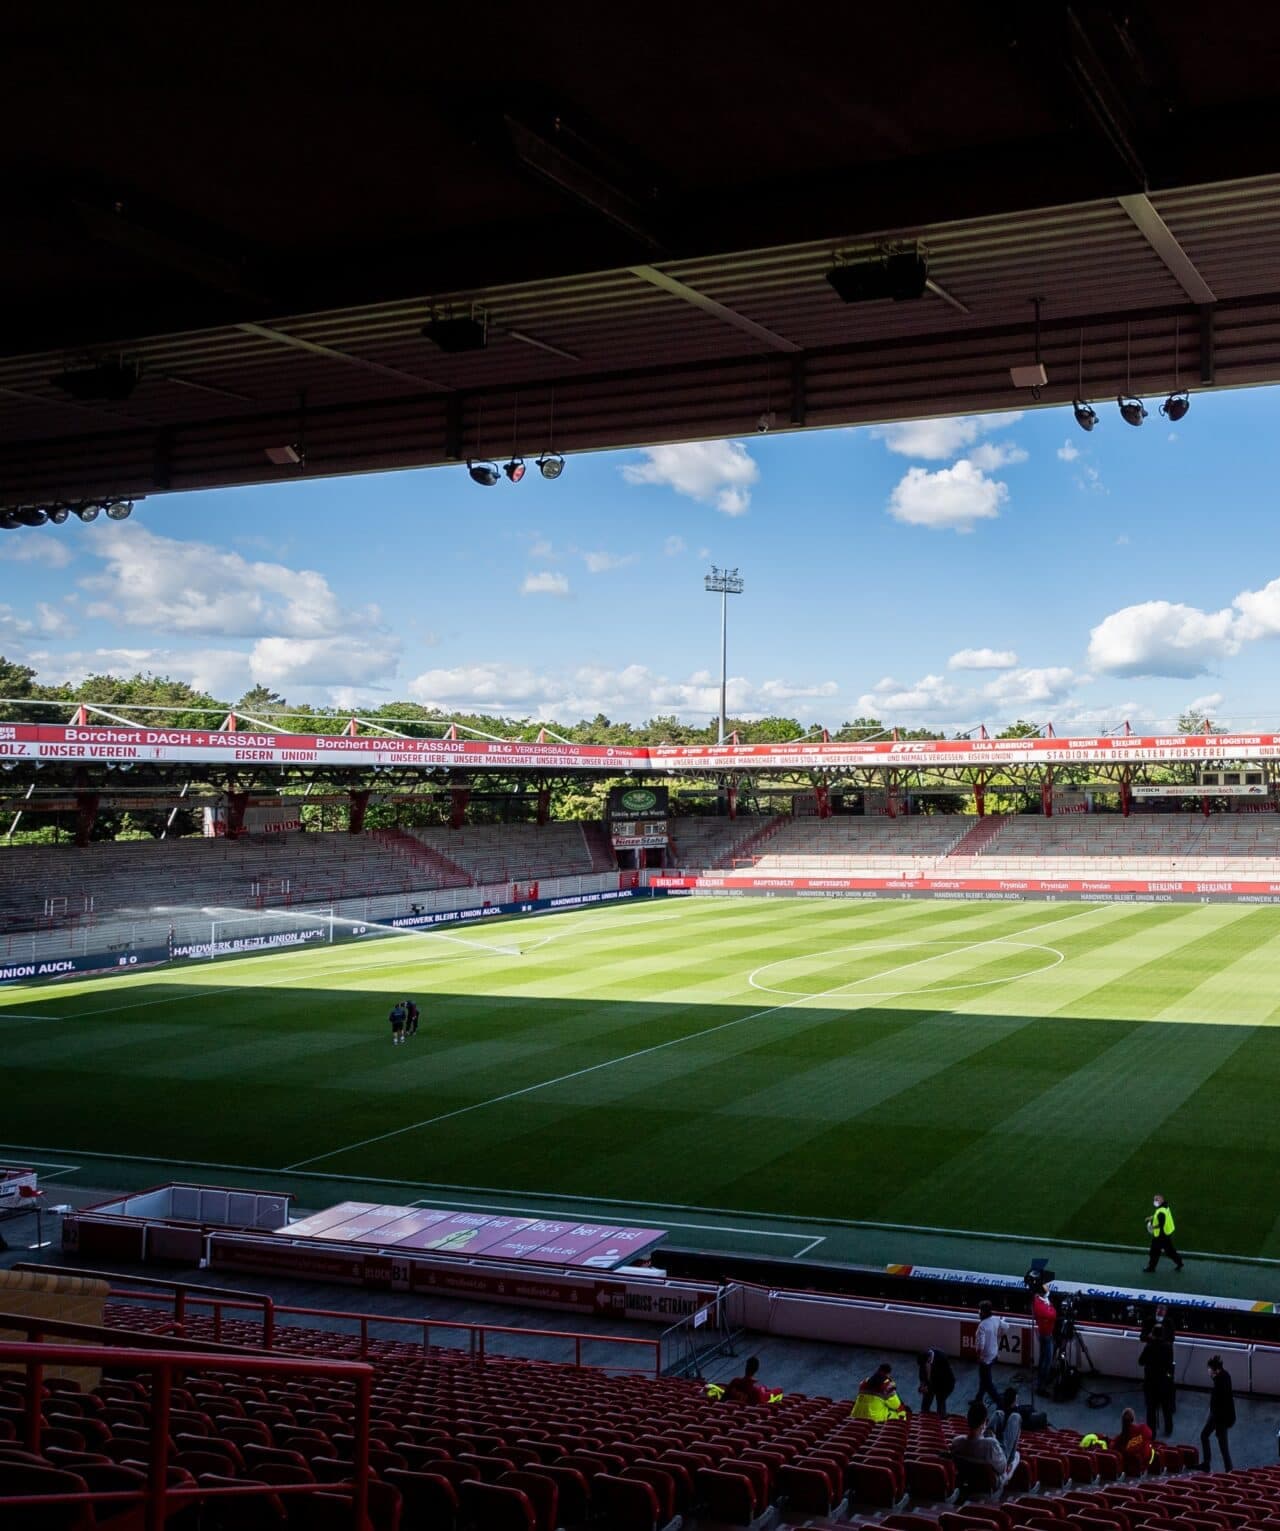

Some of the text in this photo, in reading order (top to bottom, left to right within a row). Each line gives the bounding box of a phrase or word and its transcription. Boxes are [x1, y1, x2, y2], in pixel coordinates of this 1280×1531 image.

[65, 729, 141, 743] Borchert
[147, 733, 191, 744] DACH
[209, 735, 275, 746] FASSADE
[40, 745, 84, 756] UNSER
[90, 746, 141, 758] VEREIN.
[316, 740, 368, 749] Borchert
[373, 742, 404, 751] DACH
[417, 743, 464, 752] FASSADE
[1260, 747, 1274, 755] UND
[235, 750, 317, 761] EISERN UNION!
[391, 754, 422, 762] UNSERE
[454, 755, 482, 763] UNSERE
[1046, 751, 1088, 759] STADION
[1094, 750, 1106, 758] AN
[1112, 750, 1129, 758] DER
[1135, 749, 1165, 757] ALTEN
[265, 822, 300, 833] UNION
[551, 897, 581, 906] HANDWERK
[393, 916, 433, 927] HANDWERK
[461, 910, 482, 918] UNION
[174, 942, 231, 955] HANDWERK
[269, 933, 298, 944] UNION
[39, 961, 75, 974] AUCH.
[572, 1225, 593, 1237] bei
[600, 1228, 643, 1241] uns!
[393, 1266, 408, 1282] B1
[1087, 1288, 1133, 1300] Siedler
[998, 1335, 1021, 1353] A2
